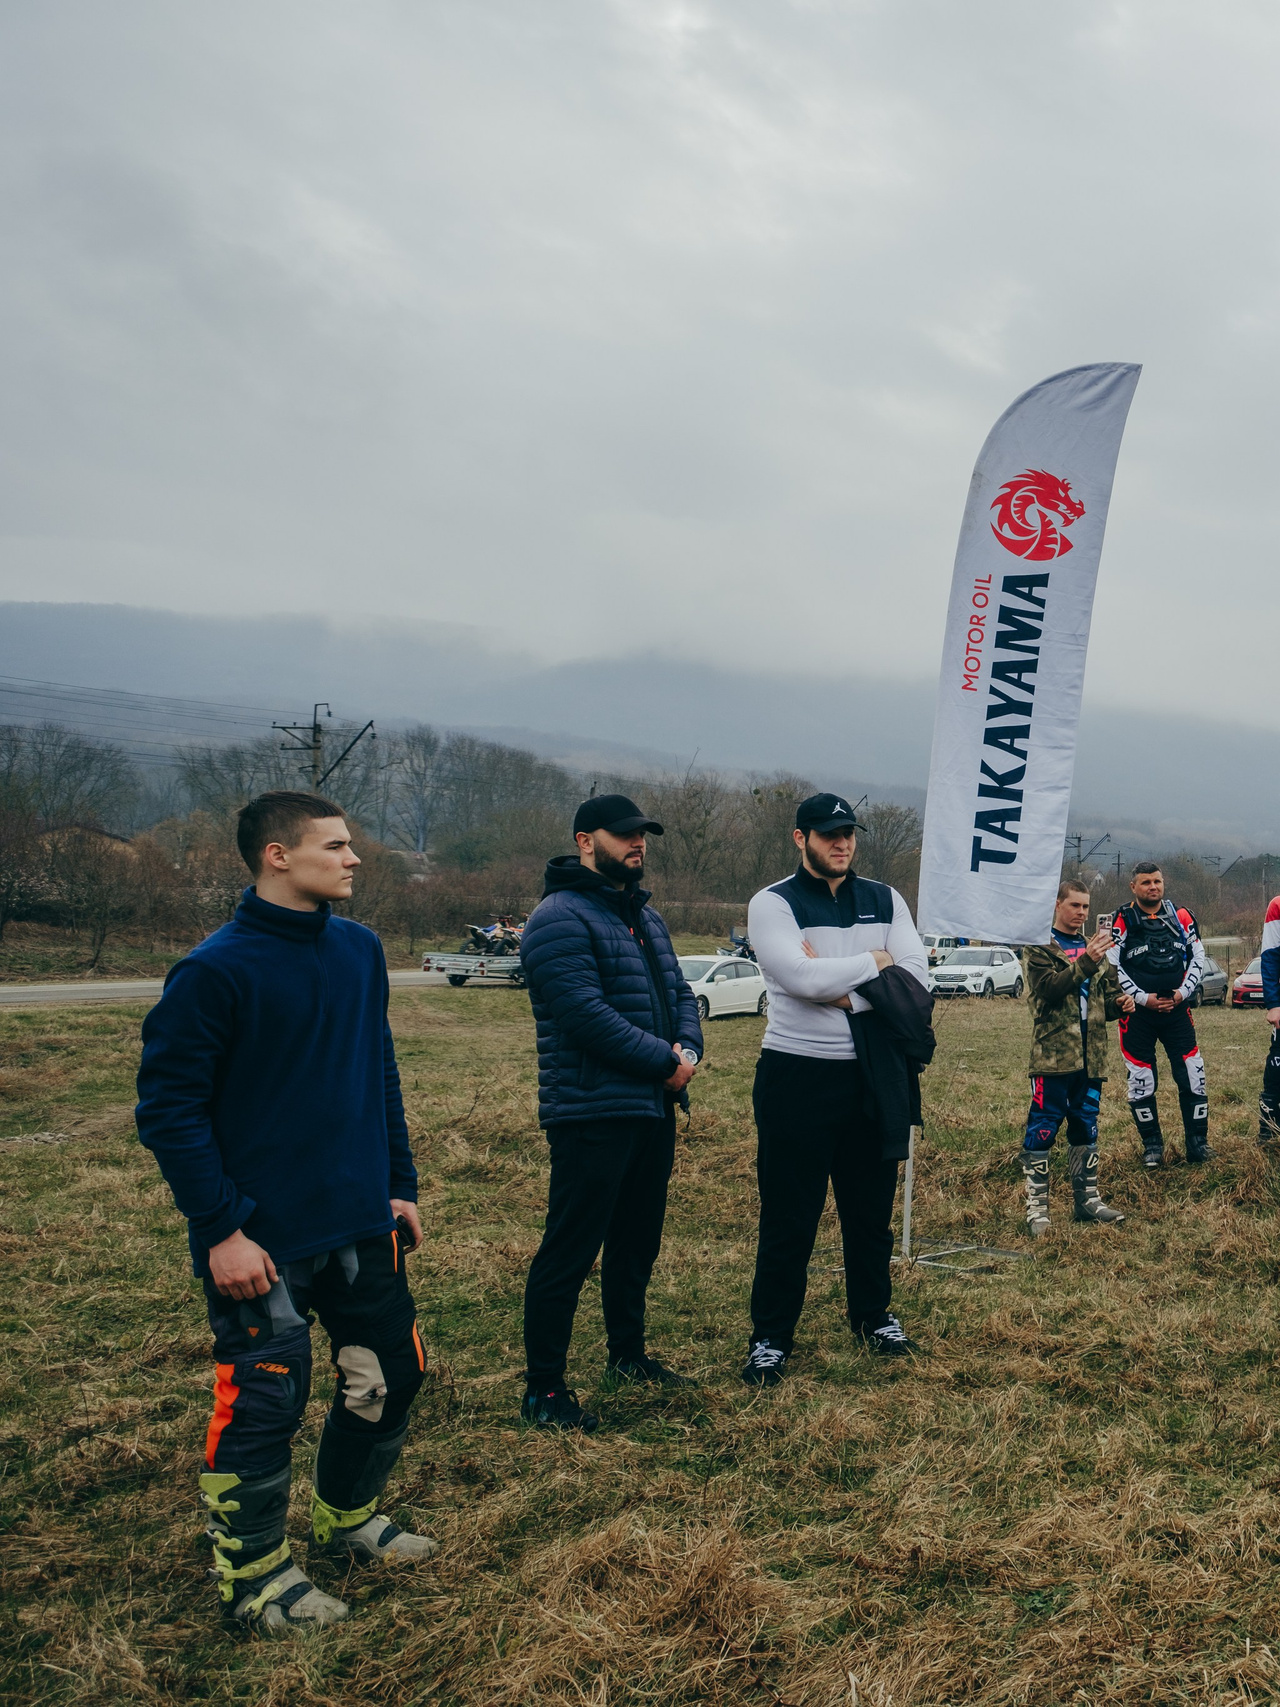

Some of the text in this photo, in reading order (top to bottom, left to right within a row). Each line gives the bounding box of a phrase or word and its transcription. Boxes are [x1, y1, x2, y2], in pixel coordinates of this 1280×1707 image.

[961, 574, 992, 692] MOTOR OIL
[970, 572, 1050, 873] TAKAYAMA
[254, 1362, 290, 1375] KTM
